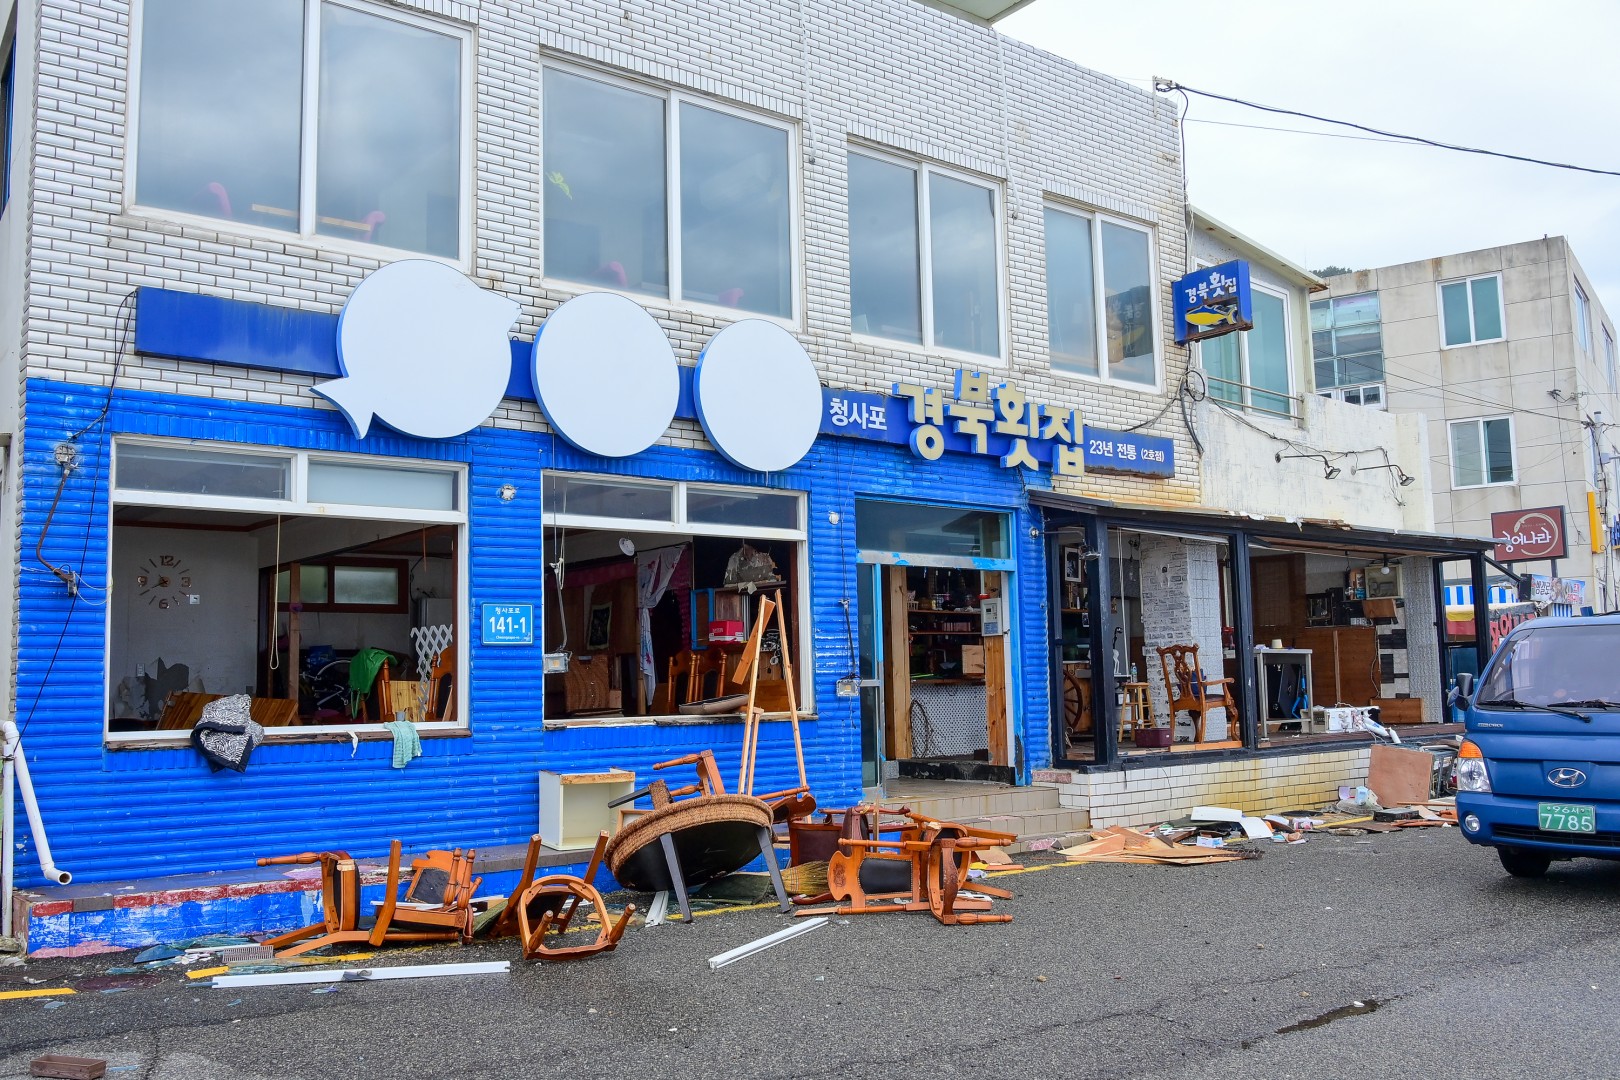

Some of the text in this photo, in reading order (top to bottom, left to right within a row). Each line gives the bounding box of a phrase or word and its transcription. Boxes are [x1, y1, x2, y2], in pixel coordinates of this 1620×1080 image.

[1185, 271, 1237, 304] 경북횟집
[829, 369, 1165, 477] 청사포 경북횟집 23년 전통 (2호점)
[160, 555, 175, 567] 12
[158, 599, 170, 610] 6
[489, 616, 526, 634] 141-1
[1540, 813, 1593, 831] 7785
